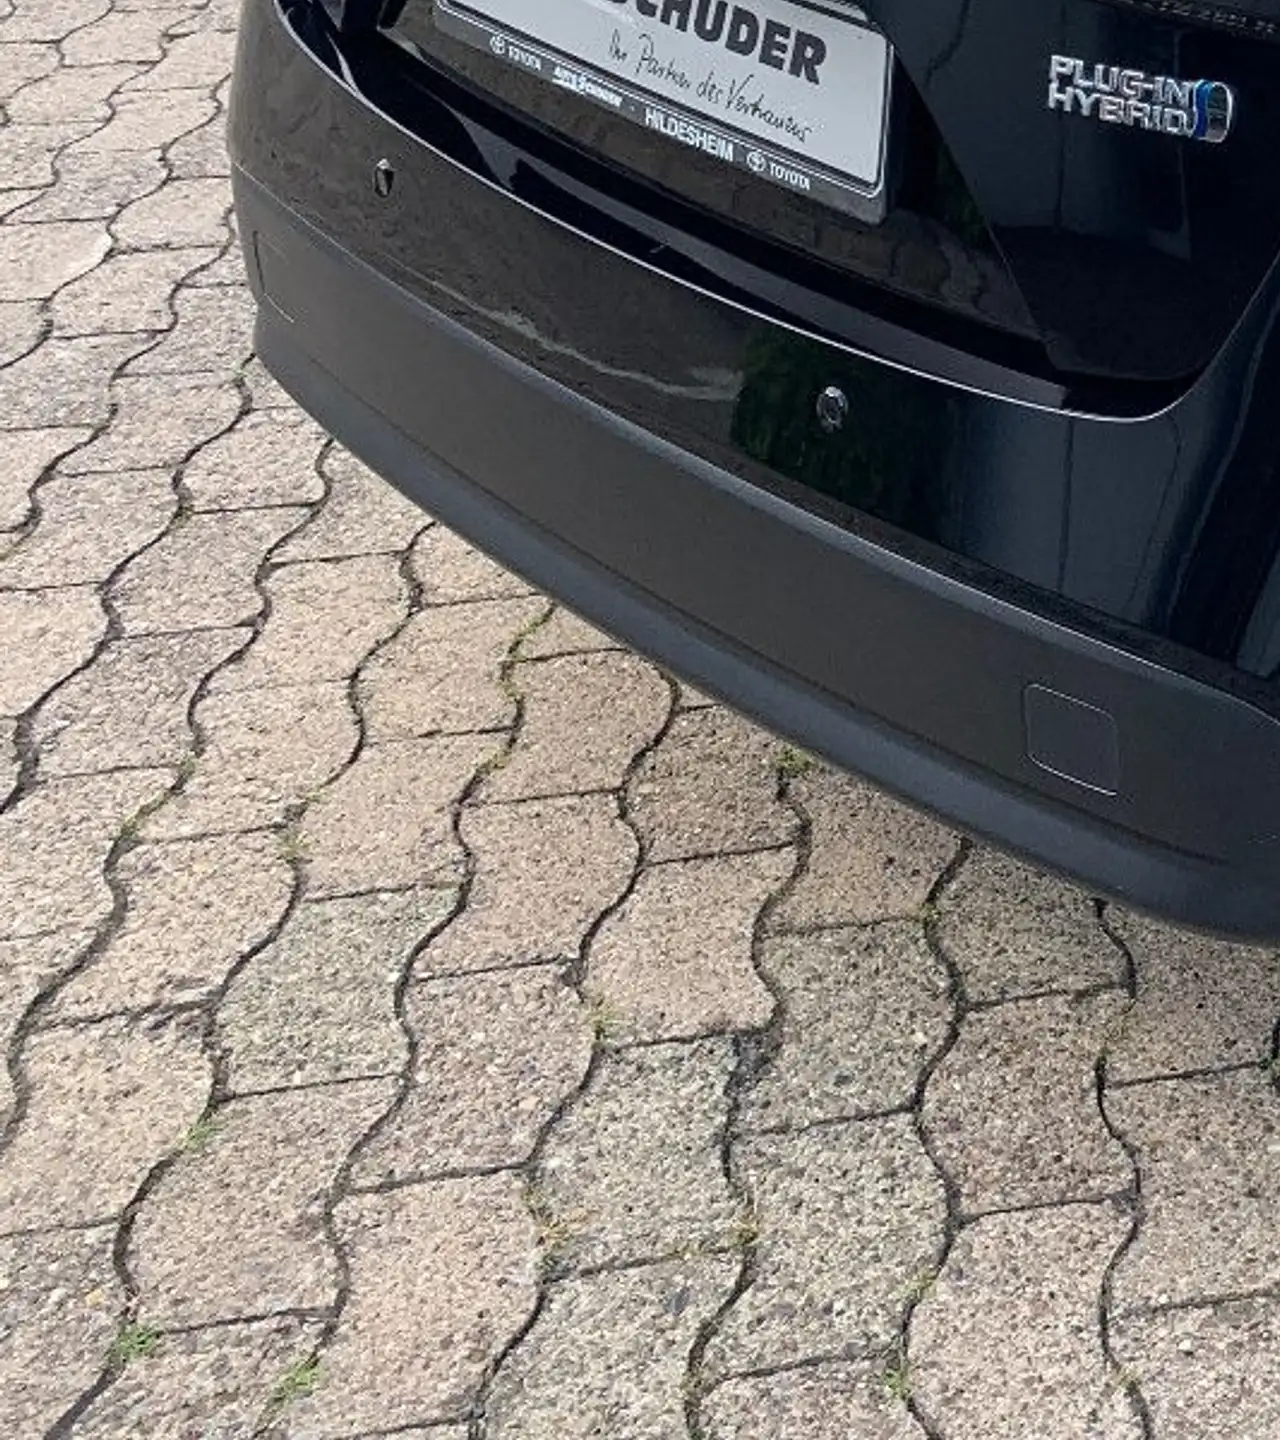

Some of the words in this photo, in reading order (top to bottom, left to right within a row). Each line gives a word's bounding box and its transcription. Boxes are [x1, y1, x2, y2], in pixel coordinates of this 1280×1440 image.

[1050, 54, 1195, 109] PLUG-IN
[1048, 82, 1195, 139] HYBRID
[645, 106, 735, 162] HILDESHEIM
[769, 163, 812, 191] TOYOTA
